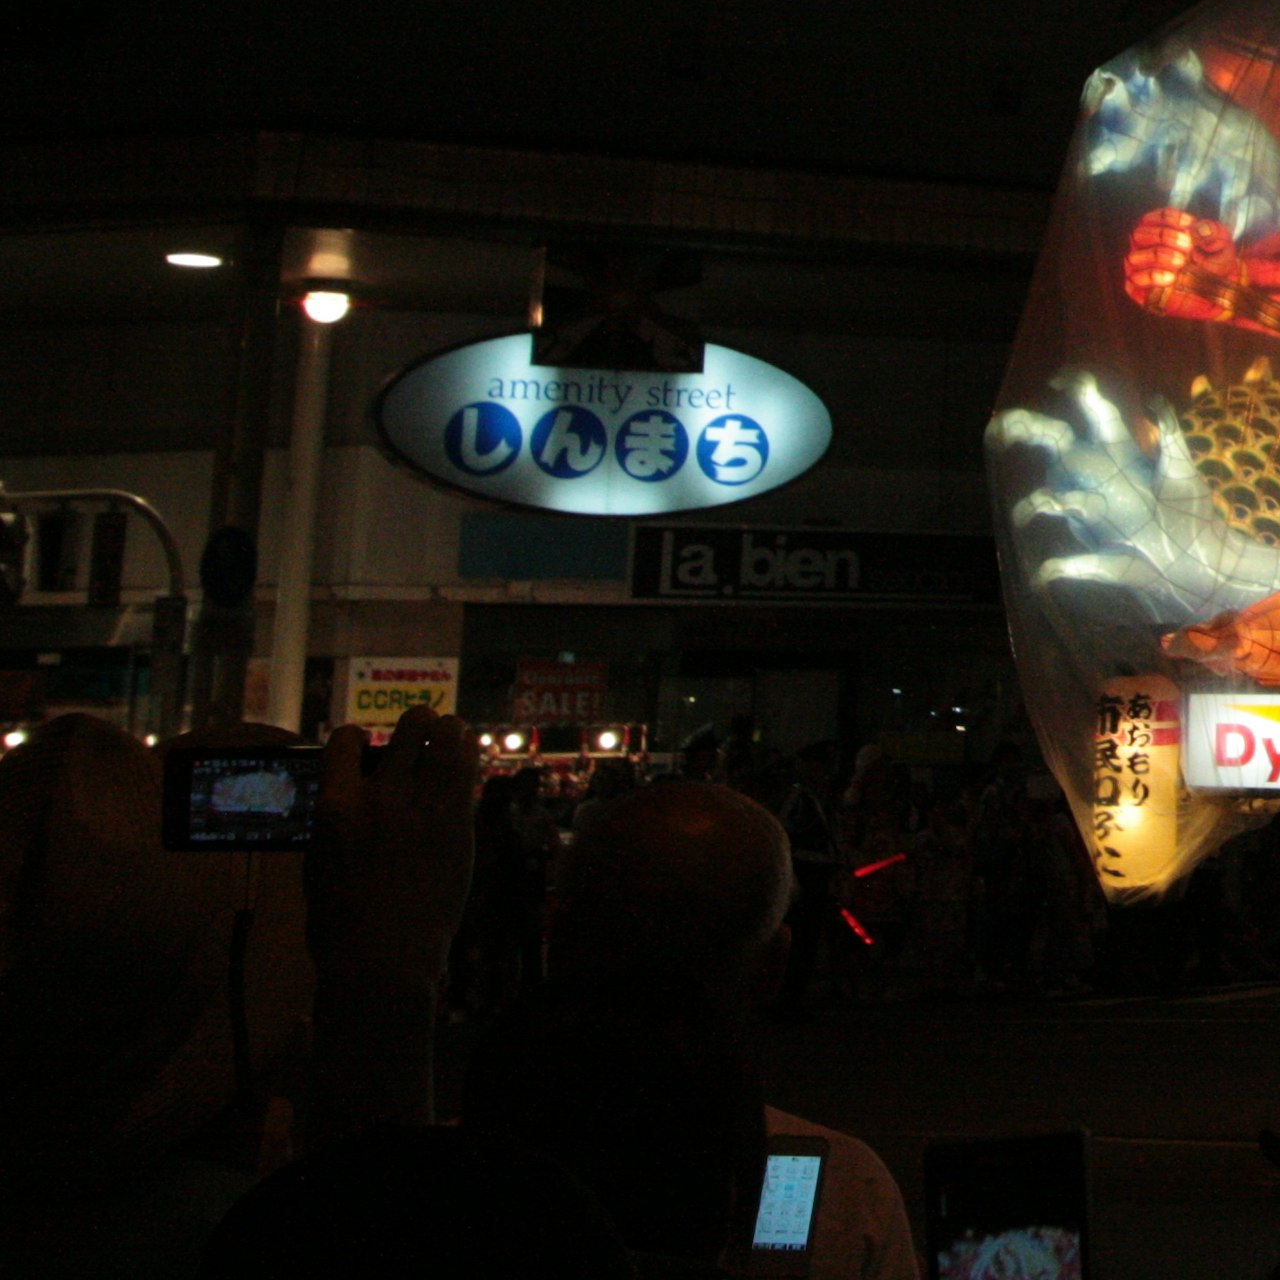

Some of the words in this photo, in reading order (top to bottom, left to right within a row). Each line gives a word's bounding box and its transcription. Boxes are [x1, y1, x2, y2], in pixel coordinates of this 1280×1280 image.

[487, 376, 633, 414] amenity
[646, 378, 736, 411] street
[455, 405, 764, 484] しんまち
